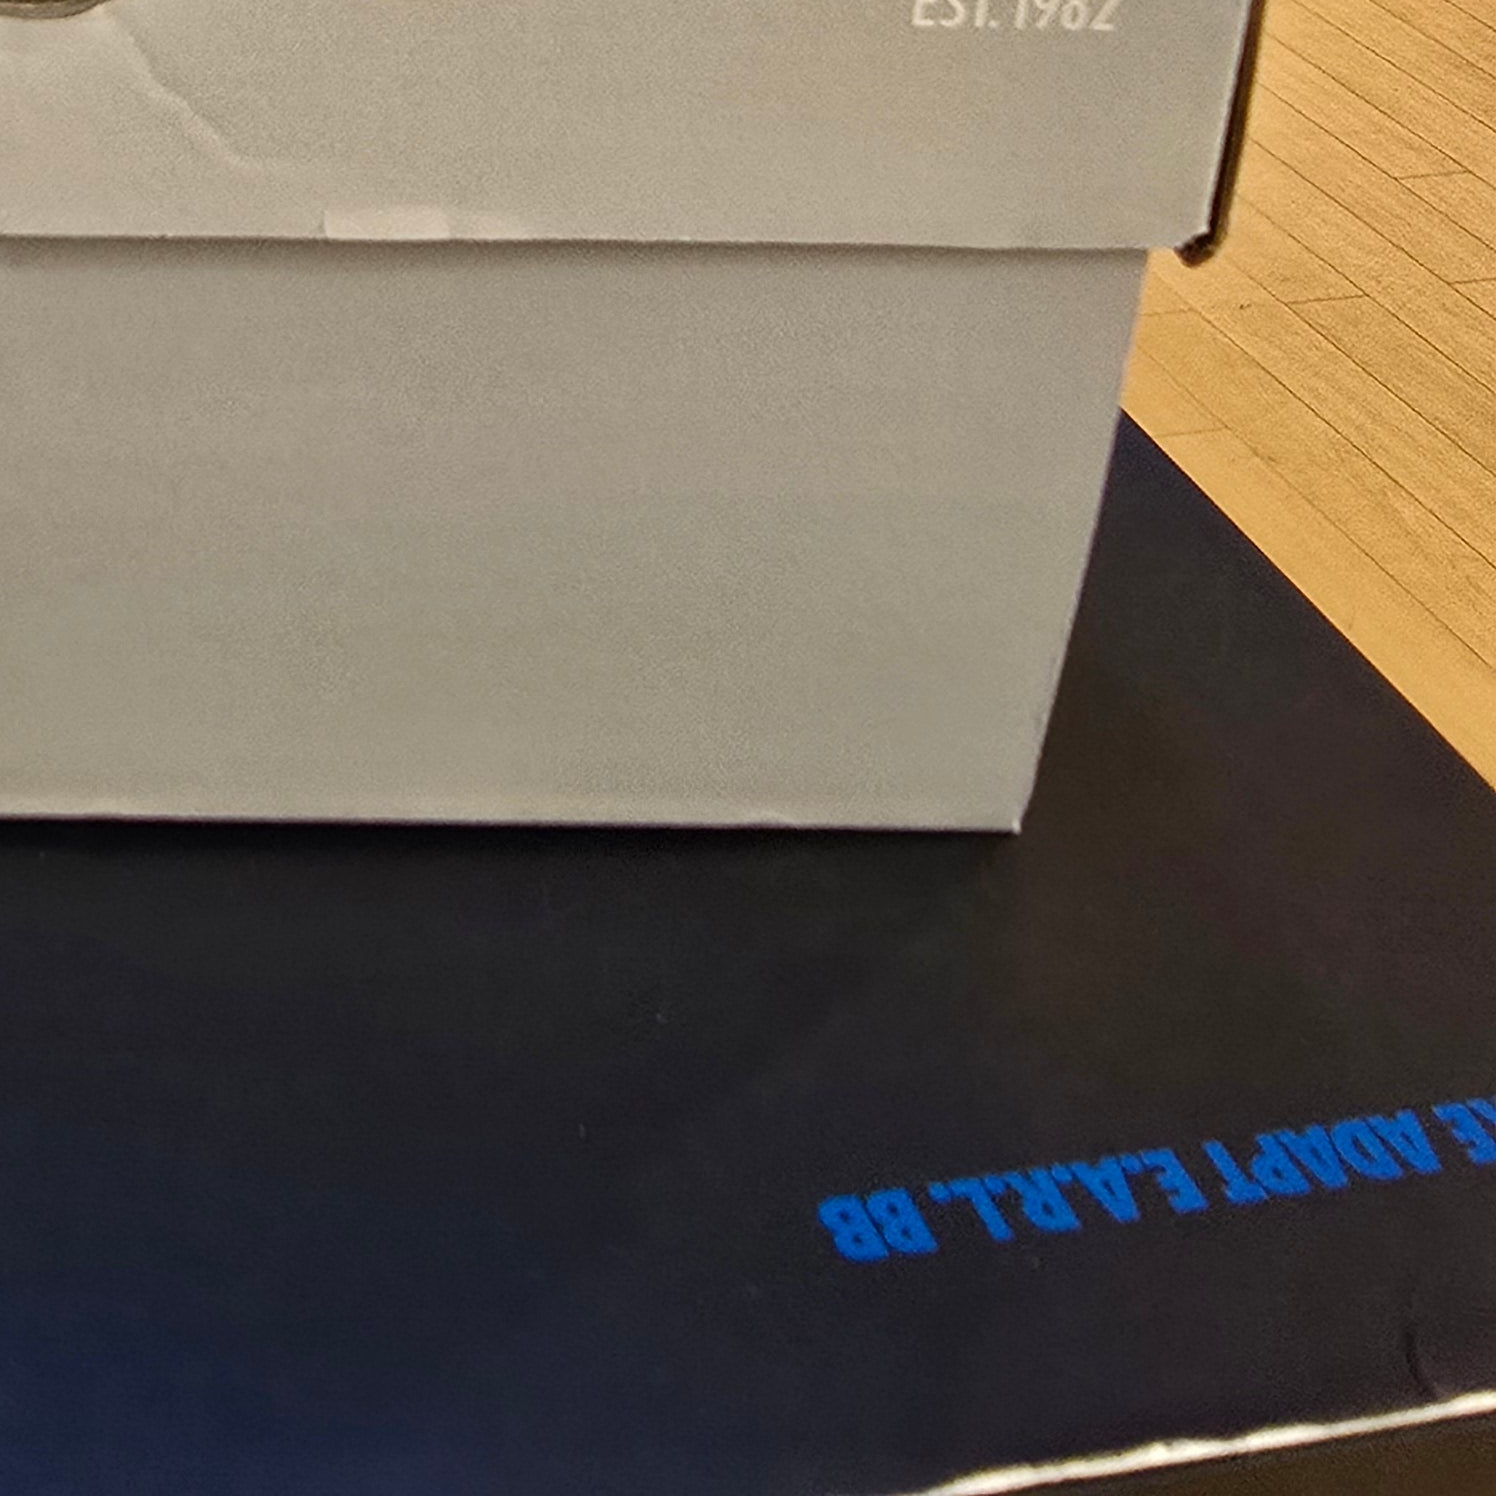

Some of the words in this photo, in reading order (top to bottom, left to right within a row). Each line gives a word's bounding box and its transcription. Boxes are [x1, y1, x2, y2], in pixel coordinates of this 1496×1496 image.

[929, 1148, 1208, 1242] E.A.R.L.
[1203, 1110, 1442, 1203] ADAPT
[817, 1187, 938, 1263] BB
